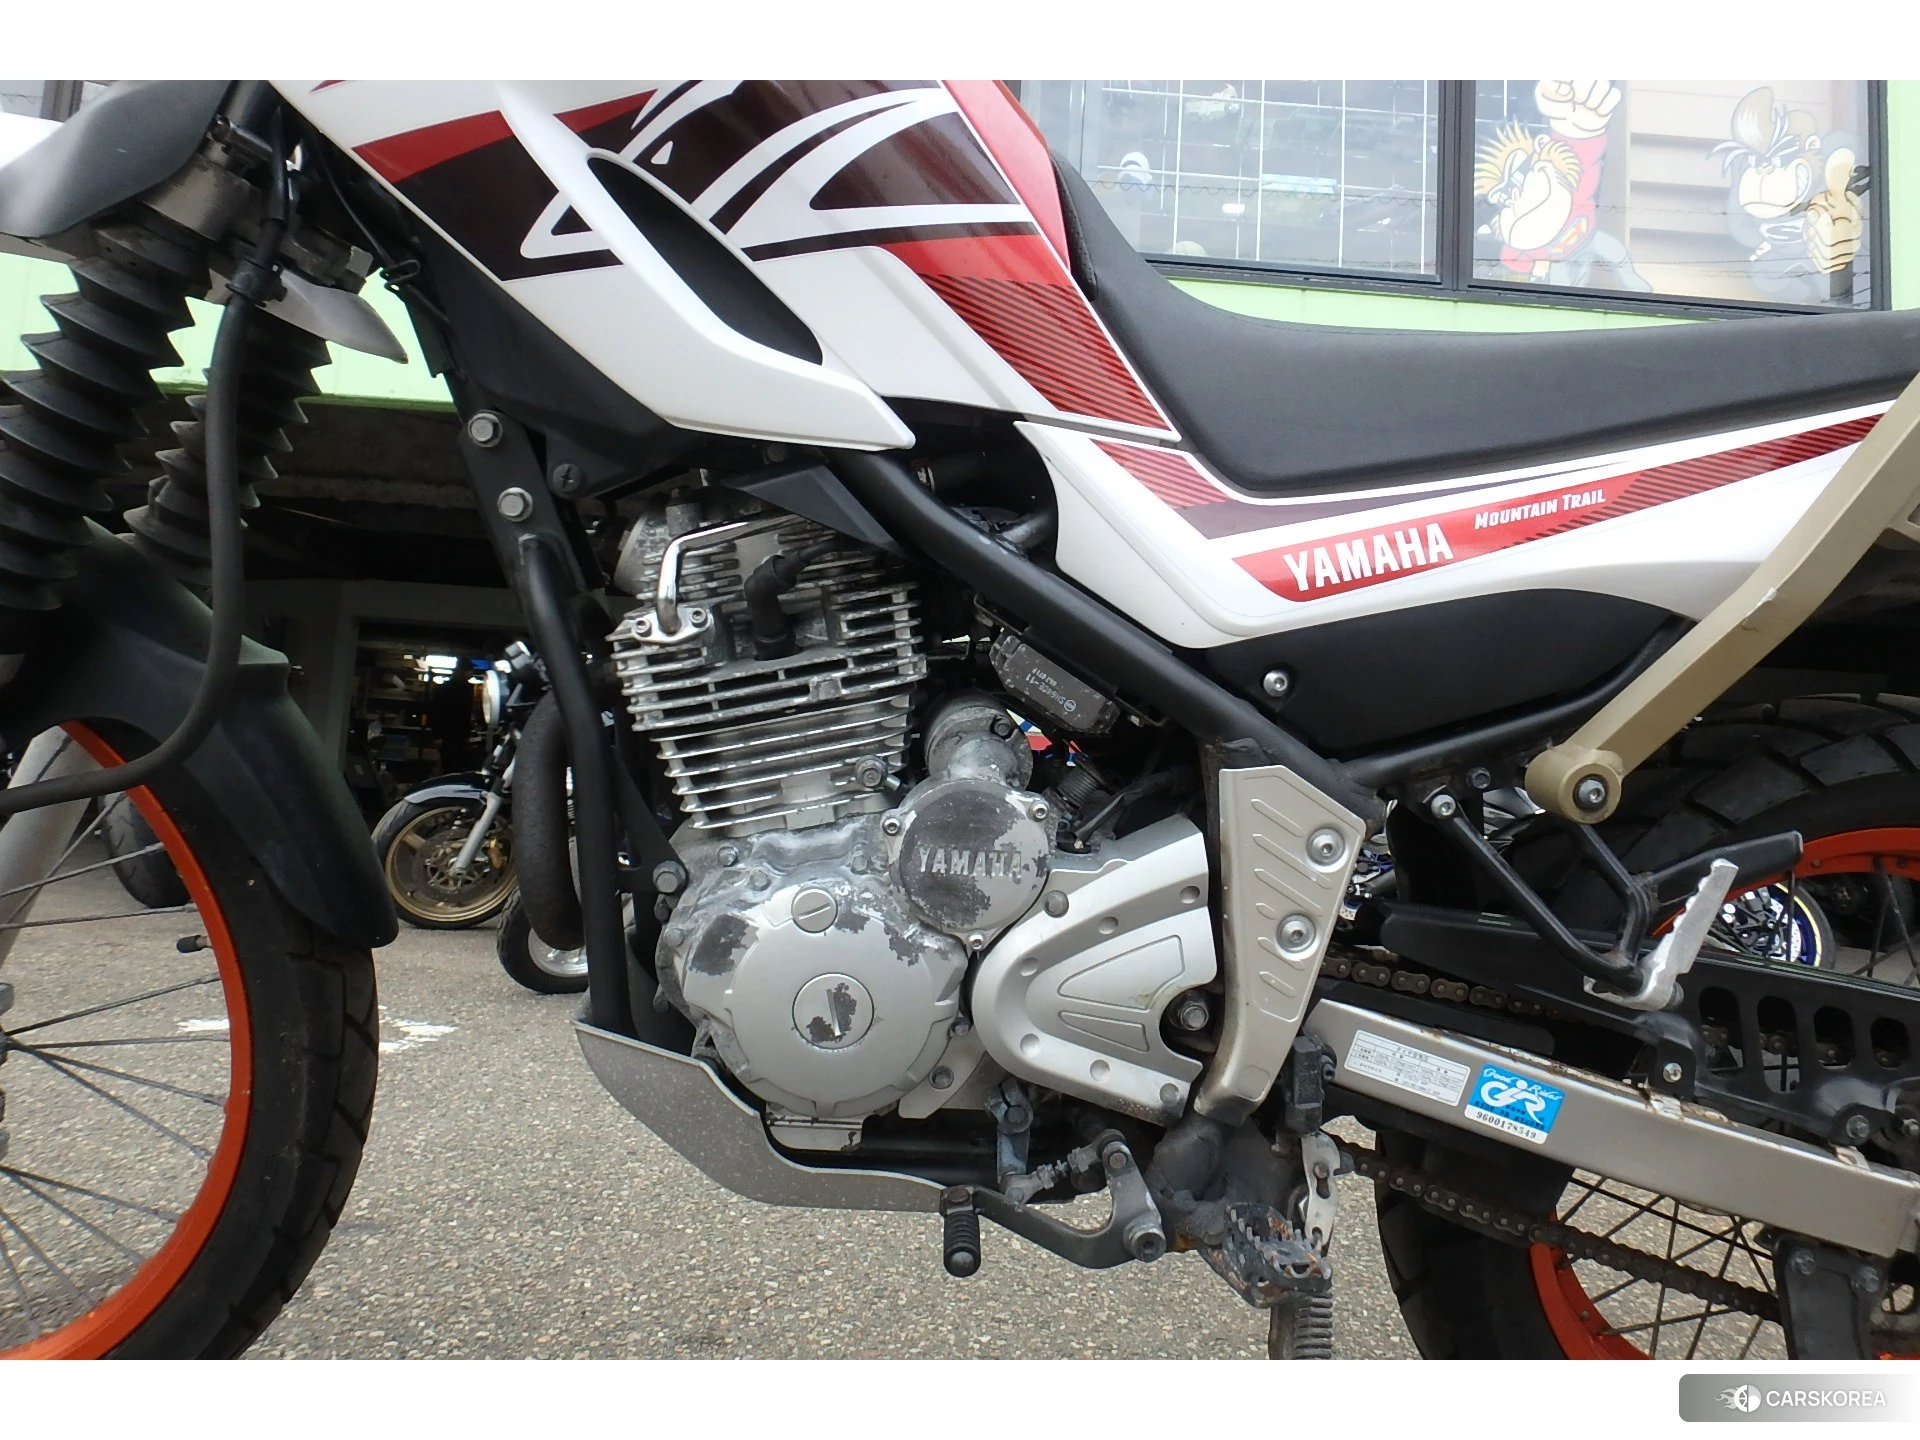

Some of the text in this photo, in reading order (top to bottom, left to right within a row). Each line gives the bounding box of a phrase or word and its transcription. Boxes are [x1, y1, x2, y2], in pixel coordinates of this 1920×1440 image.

[1474, 489, 1606, 530] MOUNTAIN TRAIL
[1283, 522, 1454, 592] YAMAHA
[918, 847, 1022, 878] YAMAHA
